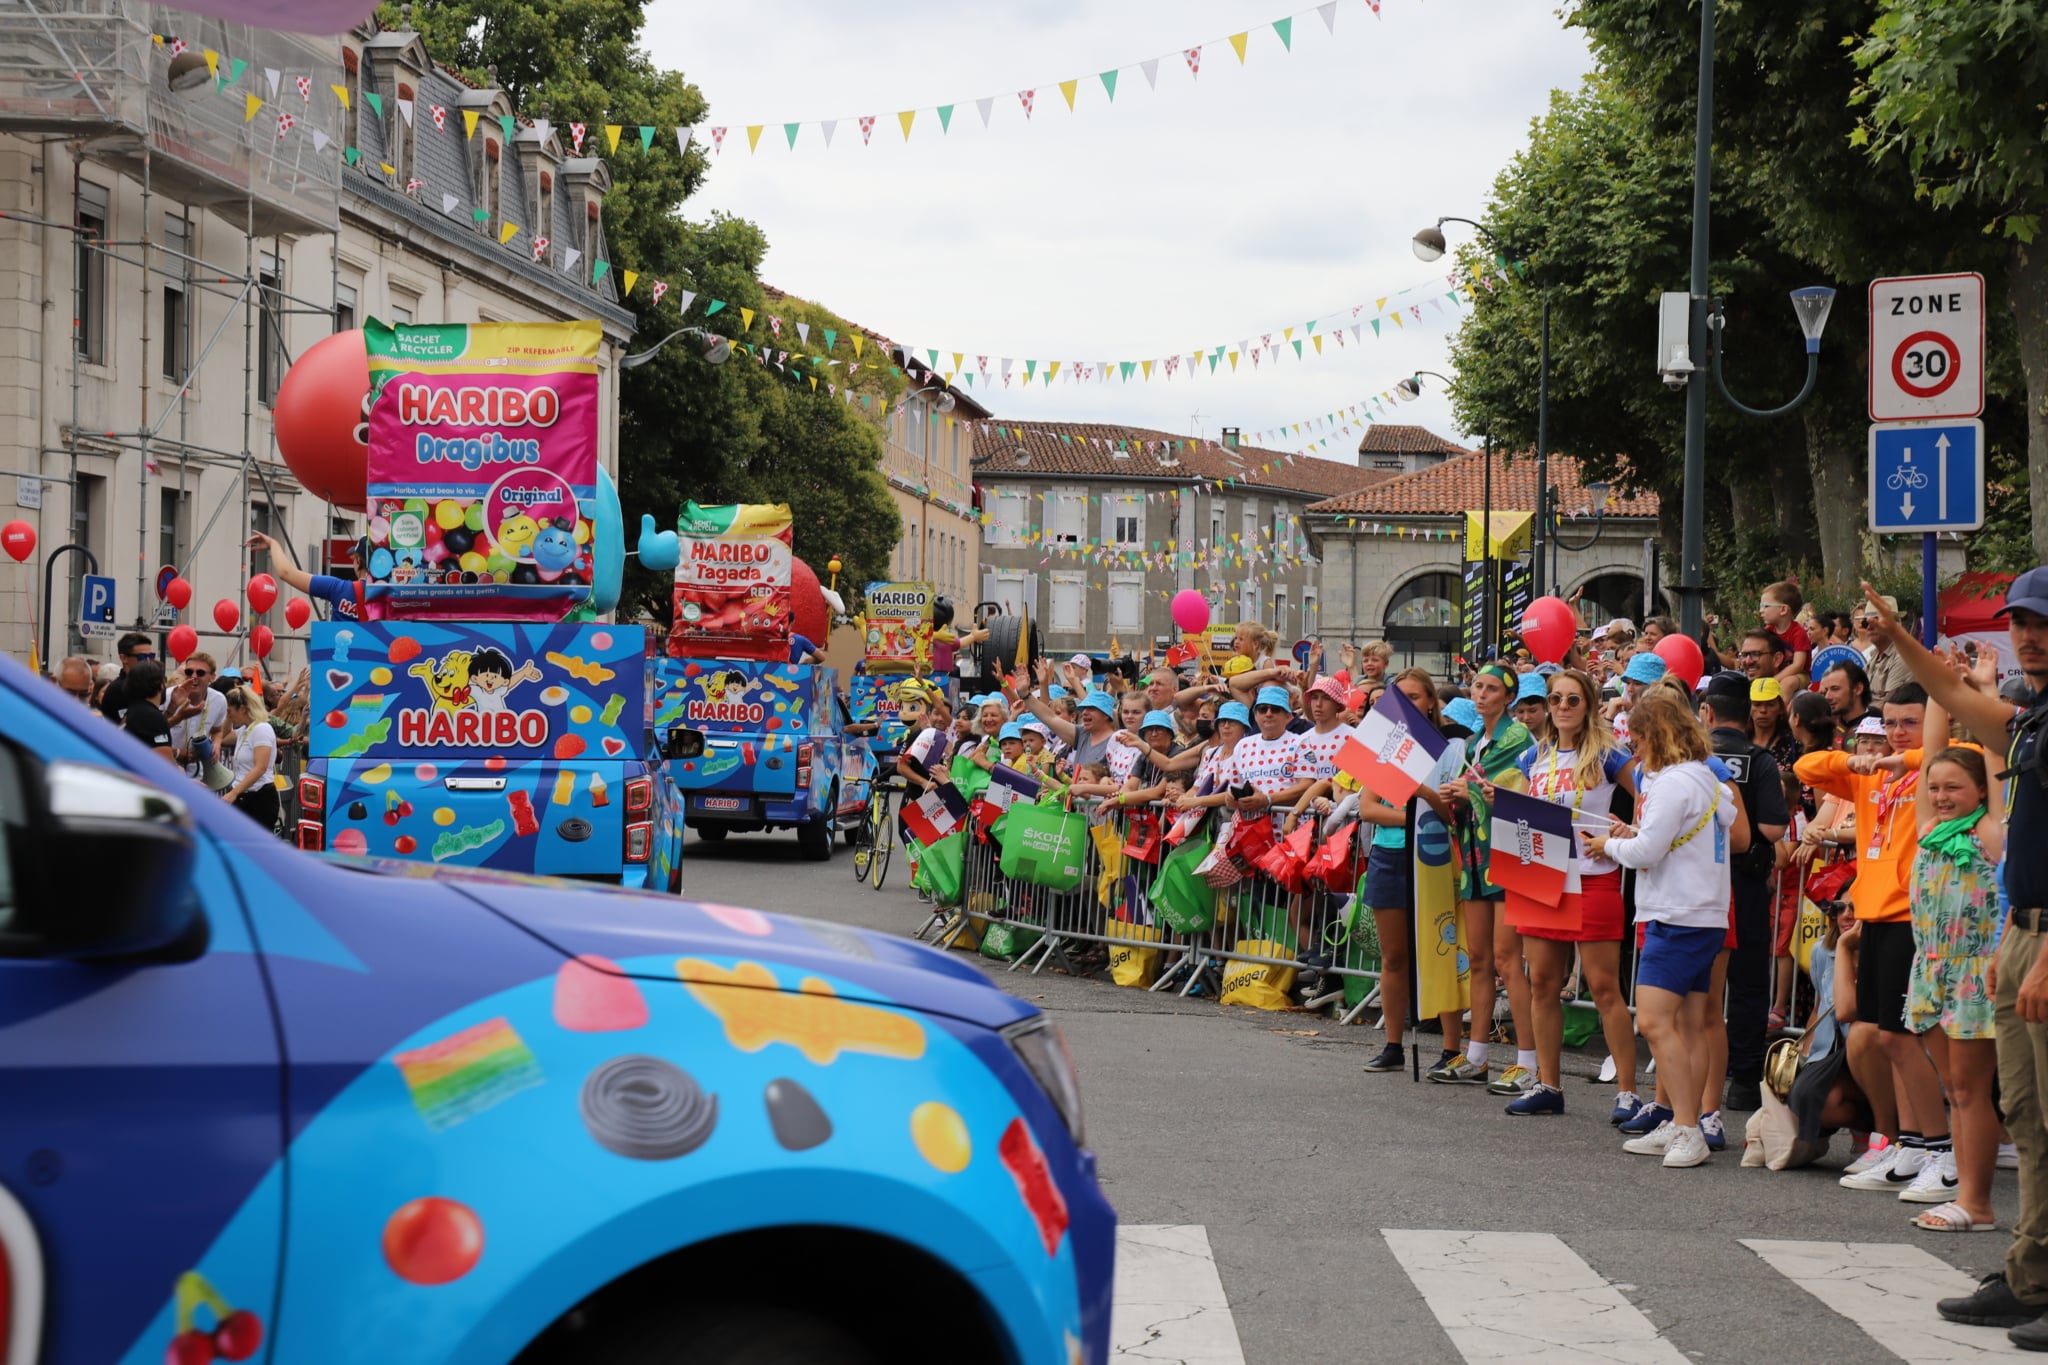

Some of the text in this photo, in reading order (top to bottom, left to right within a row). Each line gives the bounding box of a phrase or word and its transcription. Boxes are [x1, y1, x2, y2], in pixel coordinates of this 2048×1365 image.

[1891, 293, 1962, 316] ZONE
[390, 343, 453, 354] À RECYCLER
[397, 333, 441, 344] SACHET
[507, 345, 575, 356] ZIP REFERMABLE
[1905, 349, 1947, 378] 30
[399, 384, 559, 427] HARIBO
[416, 432, 540, 470] Dragibus
[501, 488, 562, 505] Original
[691, 541, 771, 564] HARIBO
[696, 563, 761, 584] Tagada
[91, 584, 107, 614] P
[750, 586, 774, 597] RED
[871, 592, 926, 605] HARIBO
[875, 608, 921, 617] Goldbears
[688, 700, 765, 723] HARIBO
[398, 707, 549, 749] HARIBO
[1395, 737, 1415, 765] XTRA
[704, 798, 740, 808] HARIBO
[1023, 827, 1072, 847] ŠKODA
[1531, 832, 1545, 860] XTRA
[1519, 839, 1531, 865] VOUS
[1802, 915, 1820, 924] c'es
[1802, 924, 1822, 944] pr
